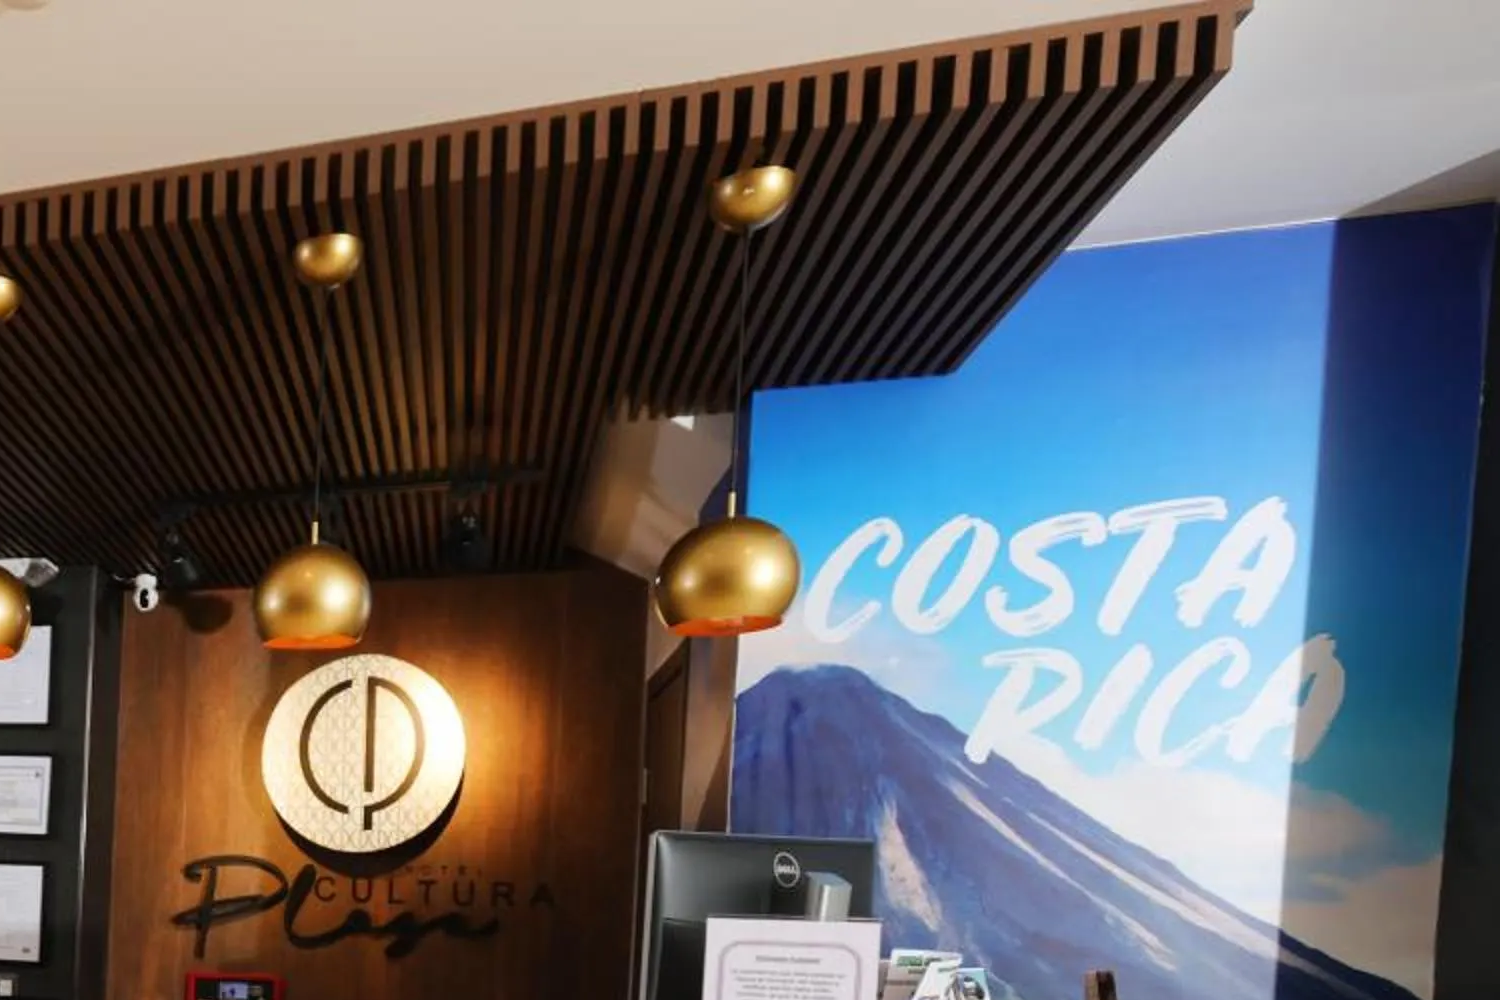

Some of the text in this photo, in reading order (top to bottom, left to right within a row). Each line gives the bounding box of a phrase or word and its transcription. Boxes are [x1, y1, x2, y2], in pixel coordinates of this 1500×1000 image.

[803, 495, 1298, 644] COSTA
[964, 632, 1346, 768] RICA
[314, 875, 557, 907] CULTURA
